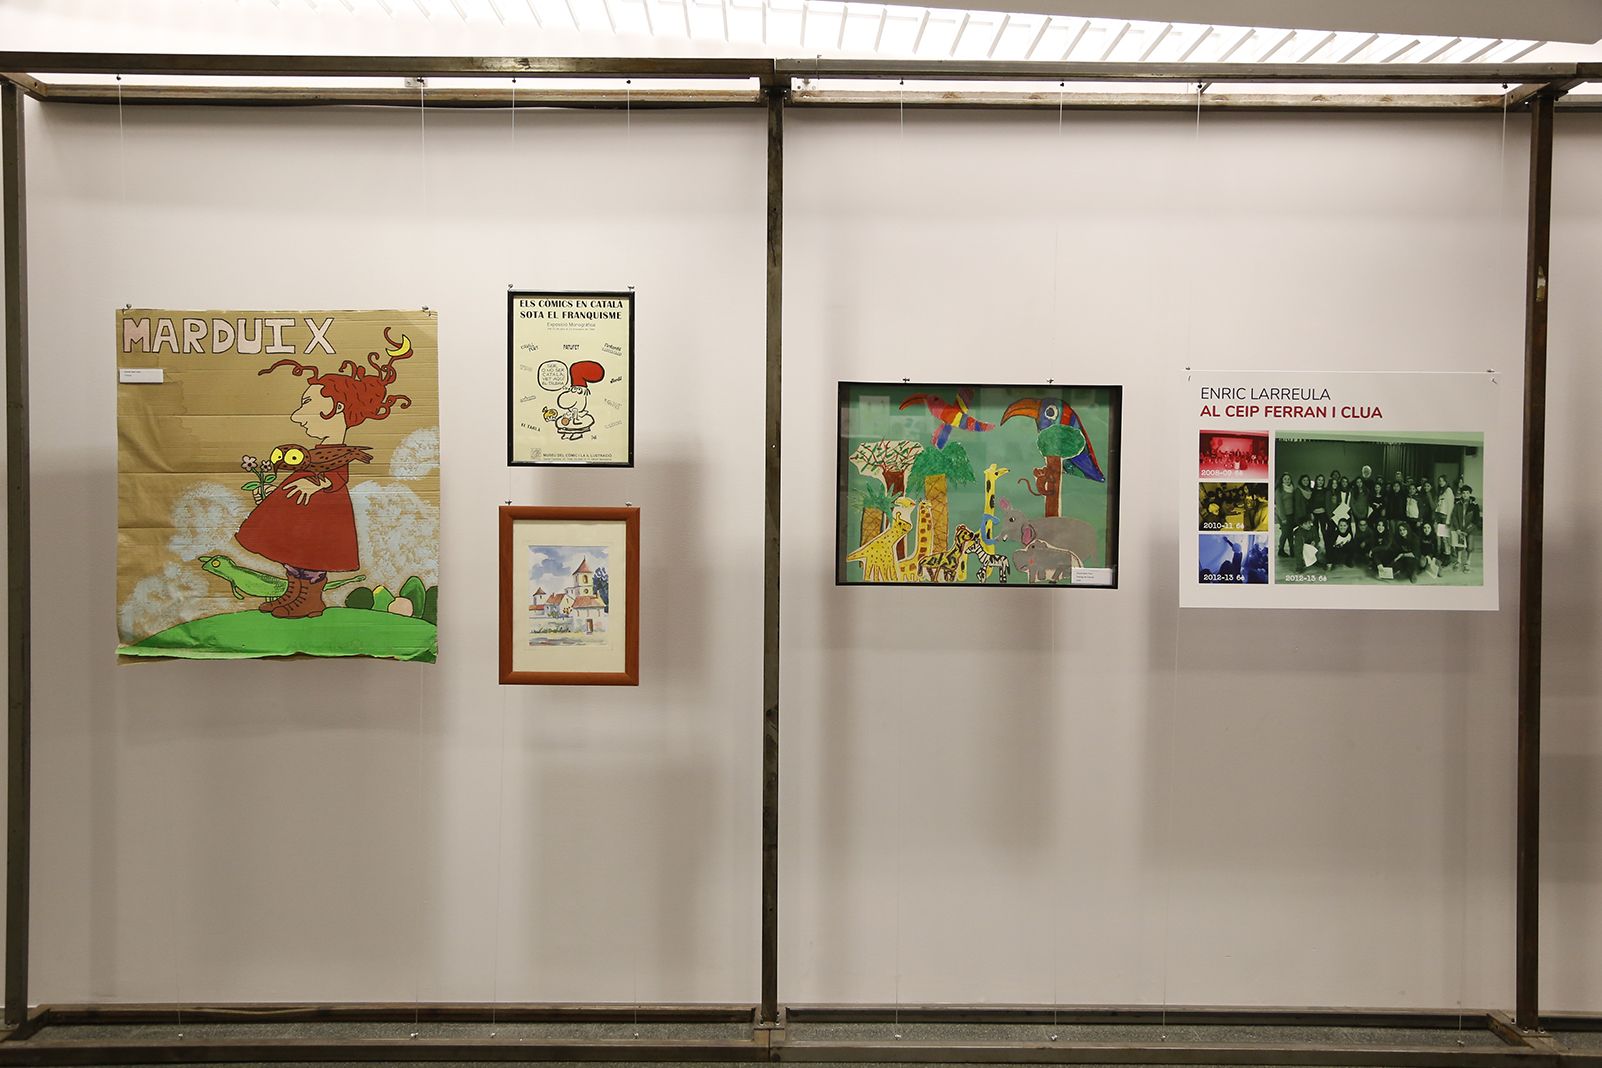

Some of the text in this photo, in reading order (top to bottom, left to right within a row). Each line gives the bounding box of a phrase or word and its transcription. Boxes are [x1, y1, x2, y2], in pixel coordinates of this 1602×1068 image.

[576, 300, 587, 308] EN
[520, 311, 622, 320] SOTA EL FRANQUISME
[1201, 387, 1331, 400] ENRIC LARREULA
[1200, 405, 1383, 418] AL CEIP FERRAN I CLUA
